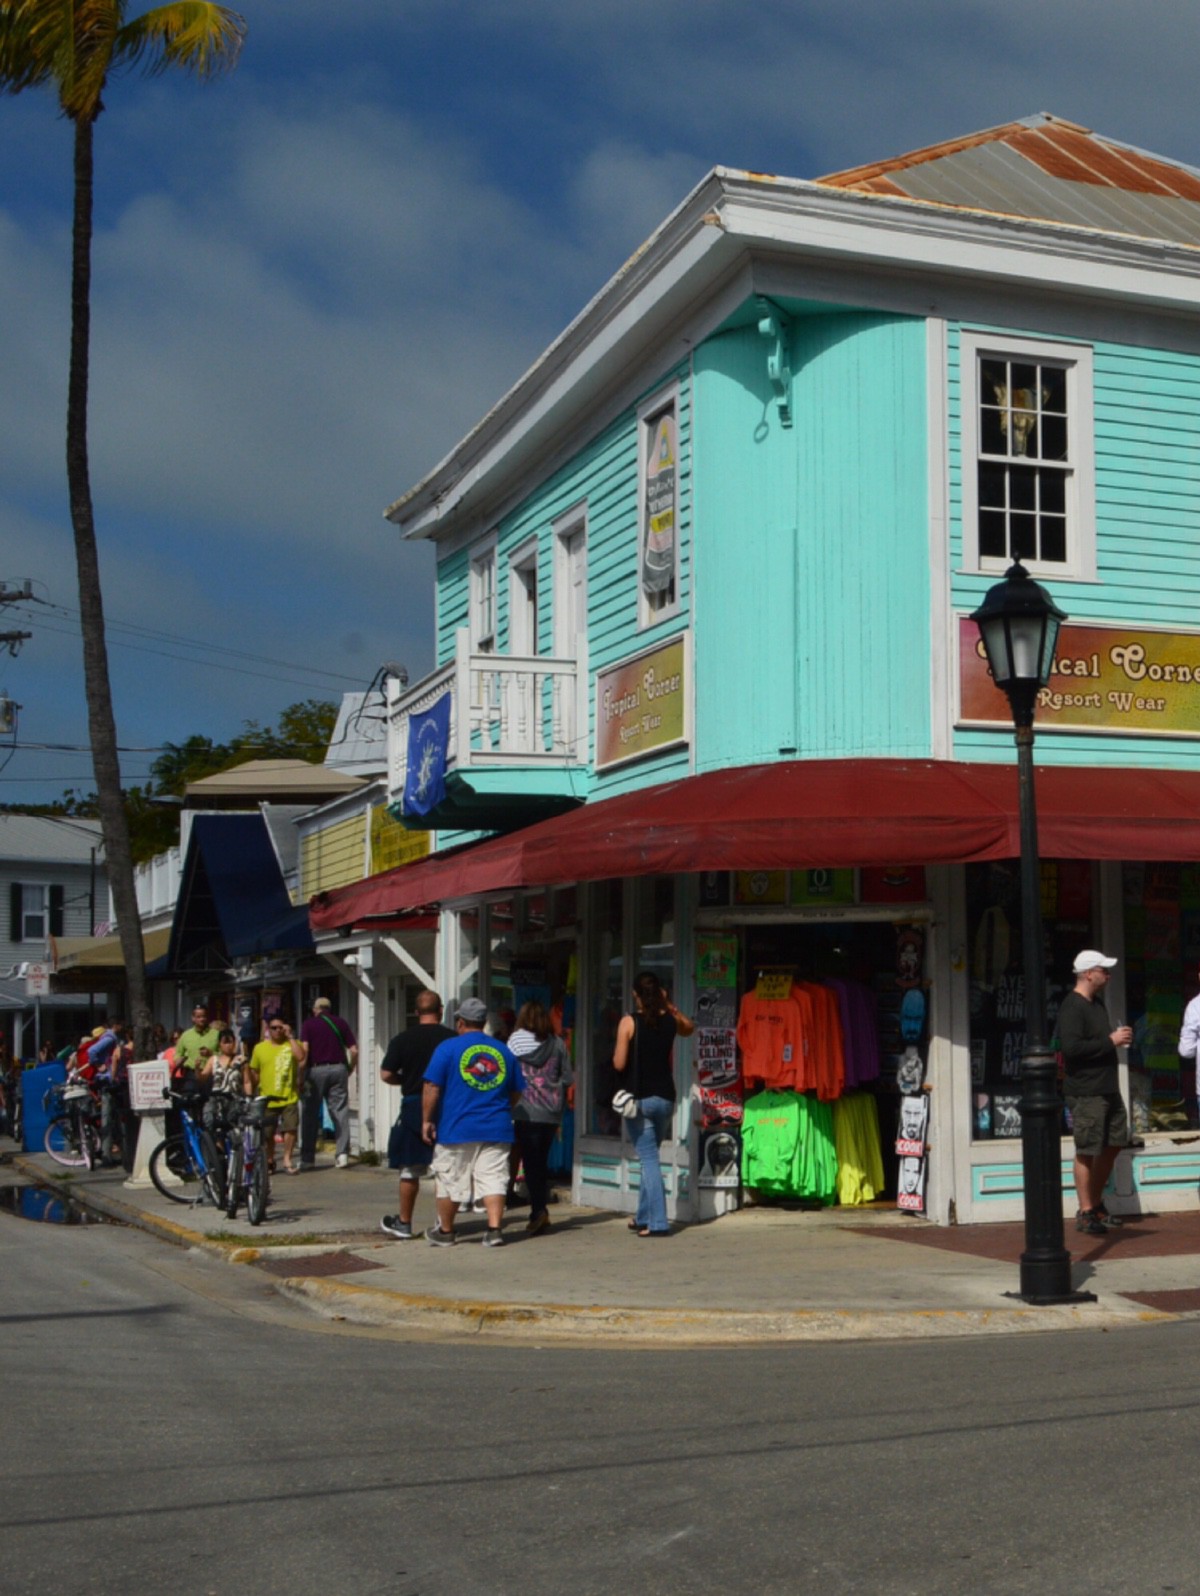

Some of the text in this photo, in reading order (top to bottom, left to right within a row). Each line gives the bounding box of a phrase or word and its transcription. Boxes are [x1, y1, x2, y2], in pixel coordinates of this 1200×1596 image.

[603, 667, 680, 722] Tropical Corner
[1038, 687, 1166, 713] Resort Wear
[999, 975, 1026, 989] AYE
[998, 990, 1023, 1003] SHE
[699, 1034, 732, 1046] ZOMBIE
[700, 1047, 733, 1058] KILLING
[703, 1059, 728, 1071] SHIRT
[139, 1073, 161, 1081] FREE
[898, 1141, 922, 1153] COOK
[900, 1195, 921, 1207] COOK
